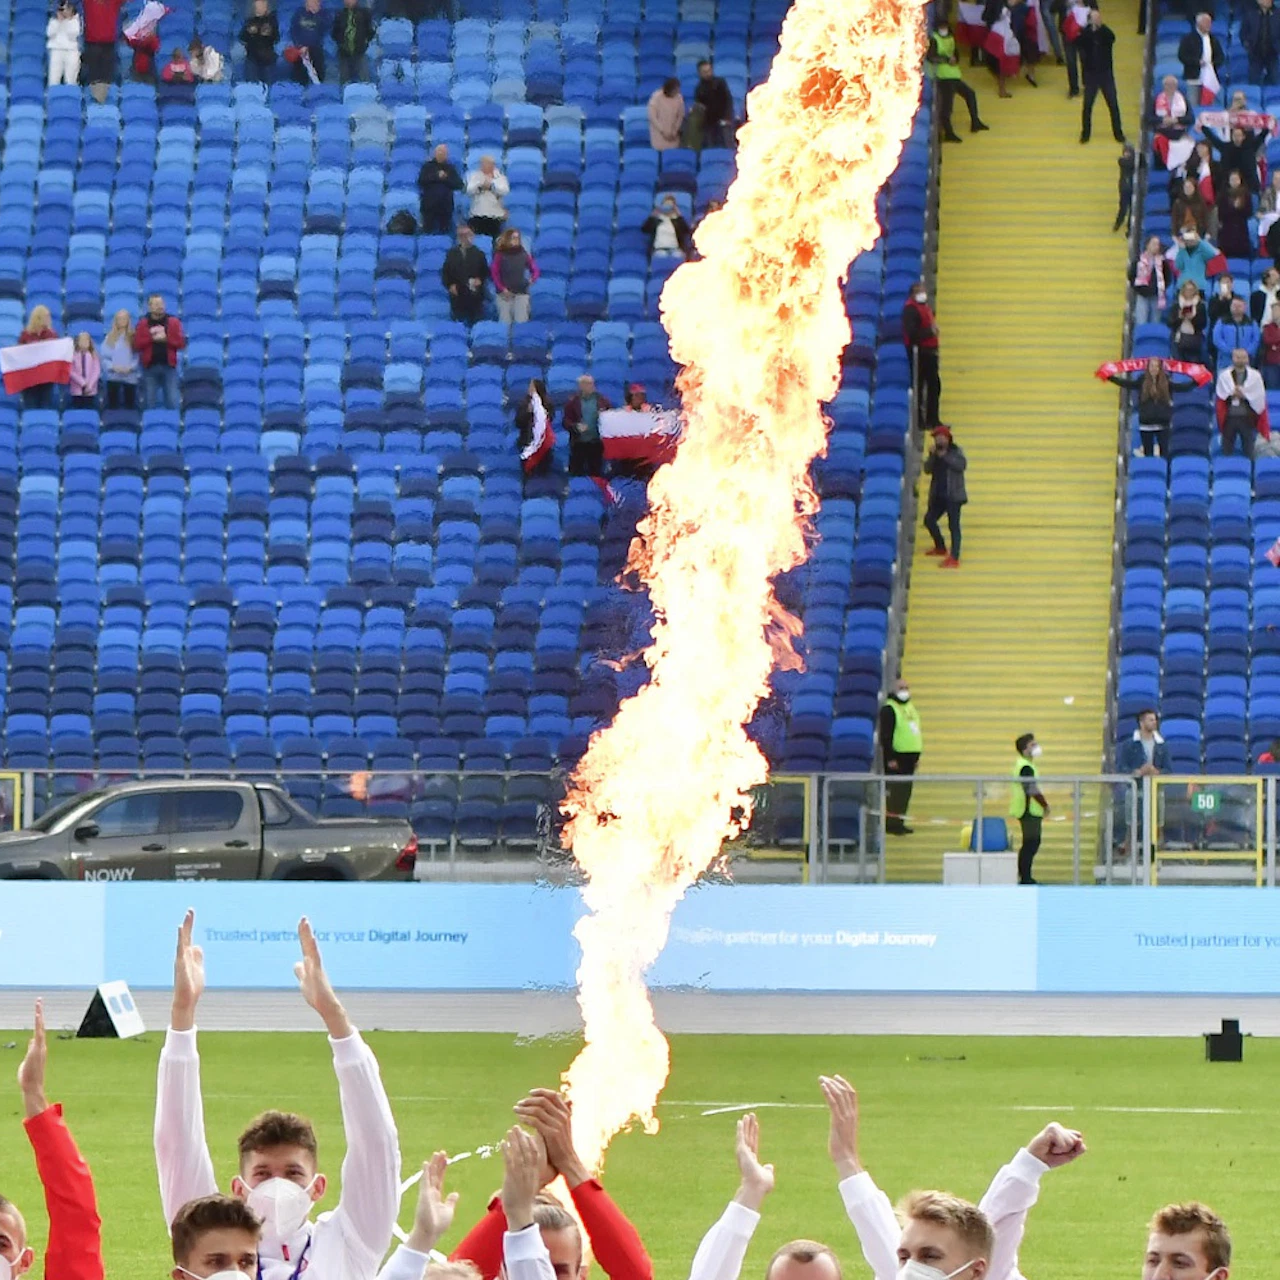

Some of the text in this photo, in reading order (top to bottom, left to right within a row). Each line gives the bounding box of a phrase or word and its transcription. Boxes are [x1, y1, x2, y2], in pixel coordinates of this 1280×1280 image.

[1197, 794, 1215, 809] 50
[84, 867, 135, 882] NOWY
[204, 928, 258, 942] Trusted
[333, 931, 366, 945] your
[368, 928, 411, 945] Digital
[414, 929, 469, 945] Journey
[801, 933, 833, 947] your
[835, 930, 879, 947] Digital
[880, 931, 937, 947] Journey
[1134, 933, 1280, 950] Trusted partner for yo
